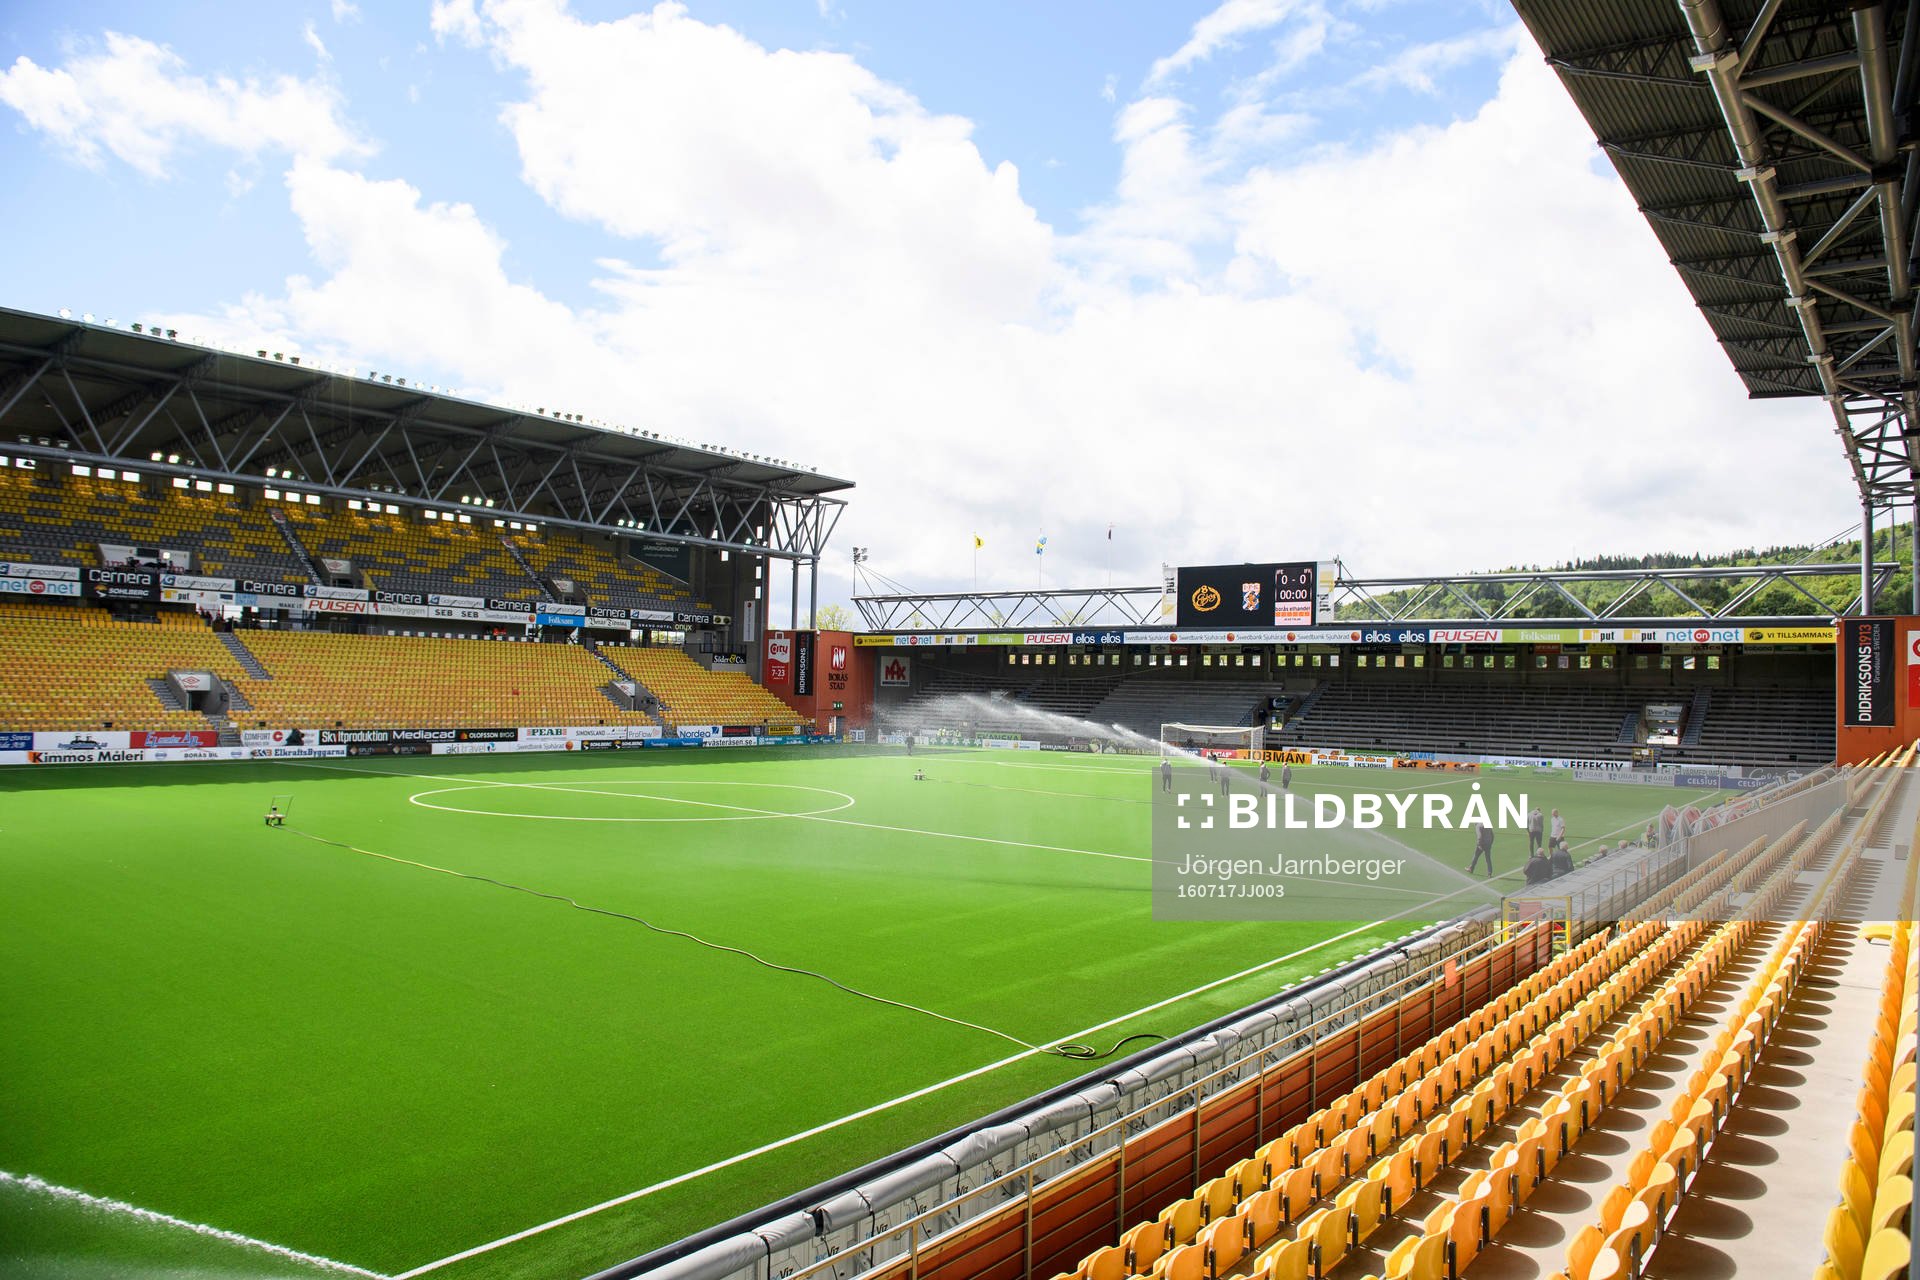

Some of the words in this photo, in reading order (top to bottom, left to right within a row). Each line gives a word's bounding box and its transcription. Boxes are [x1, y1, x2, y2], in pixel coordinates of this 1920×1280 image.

[89, 568, 151, 586] Cernera
[1281, 575, 1288, 585] 0
[1300, 574, 1306, 584] 0
[108, 587, 149, 596] SOHLBERG
[243, 580, 297, 595] Cernera
[375, 591, 422, 604] Cernera
[1280, 589, 1308, 600] 00:00
[309, 599, 366, 613] PULSEN
[380, 604, 426, 615] Riksbyggen
[490, 600, 531, 612] Cernera
[435, 609, 453, 617] SEB
[461, 610, 479, 618] SEB
[590, 607, 626, 618] Cernera
[677, 613, 710, 624] Cernera
[1026, 634, 1070, 643] PULSEN
[1076, 633, 1095, 644] ellos
[1101, 633, 1121, 644] ellos
[1365, 630, 1391, 643] ellos
[1399, 630, 1425, 643] ellos
[1433, 630, 1498, 642] PULSEN
[1777, 631, 1833, 639] TILLSAMMANS
[828, 672, 848, 682] BORÅS
[321, 731, 389, 743] Skyltproduktion
[392, 730, 456, 740] Mediacad
[468, 732, 499, 740] OLOFSSON
[531, 729, 563, 737] PEAB
[679, 731, 711, 739] Nordea
[32, 752, 94, 763] Kimmos
[97, 750, 144, 762] Måleri
[1247, 750, 1306, 764] JOBMAN
[1504, 759, 1540, 767] SKEPPSHULT
[1570, 760, 1624, 771] EFFEKTIV
[1687, 777, 1717, 786] CELSIUS
